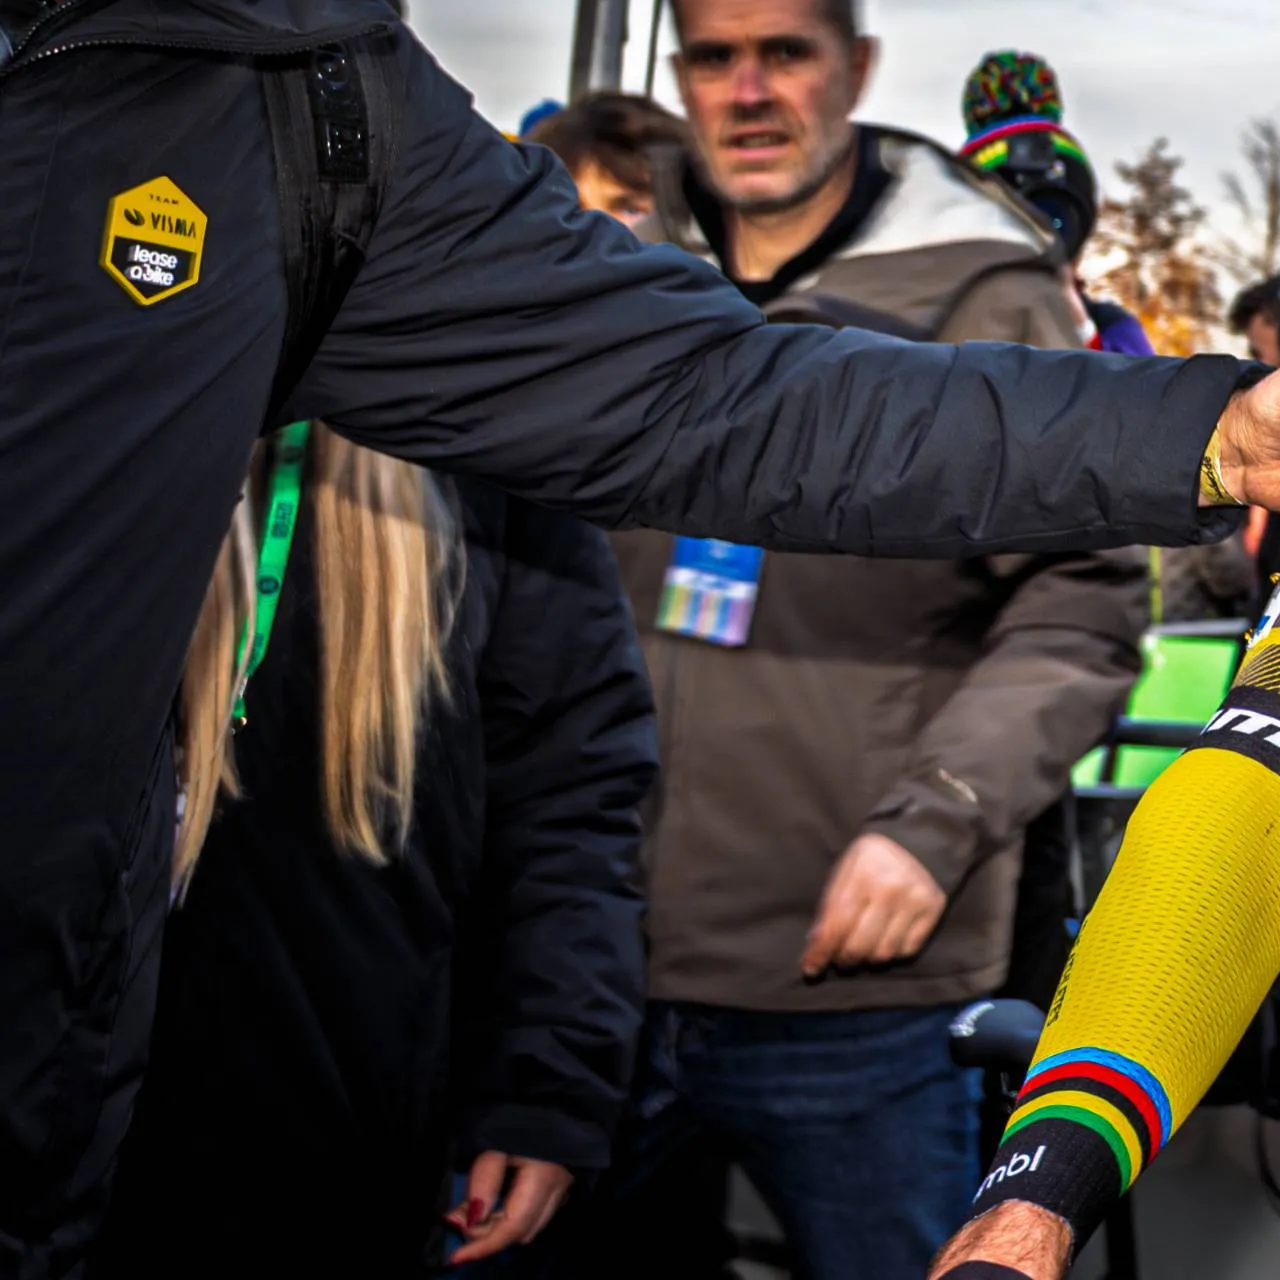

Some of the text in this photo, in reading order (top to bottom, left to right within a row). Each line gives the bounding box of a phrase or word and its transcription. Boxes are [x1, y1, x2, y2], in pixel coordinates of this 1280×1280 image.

[151, 211, 197, 239] VISMA
[129, 244, 178, 270] lease
[973, 1144, 1048, 1205] mbl
